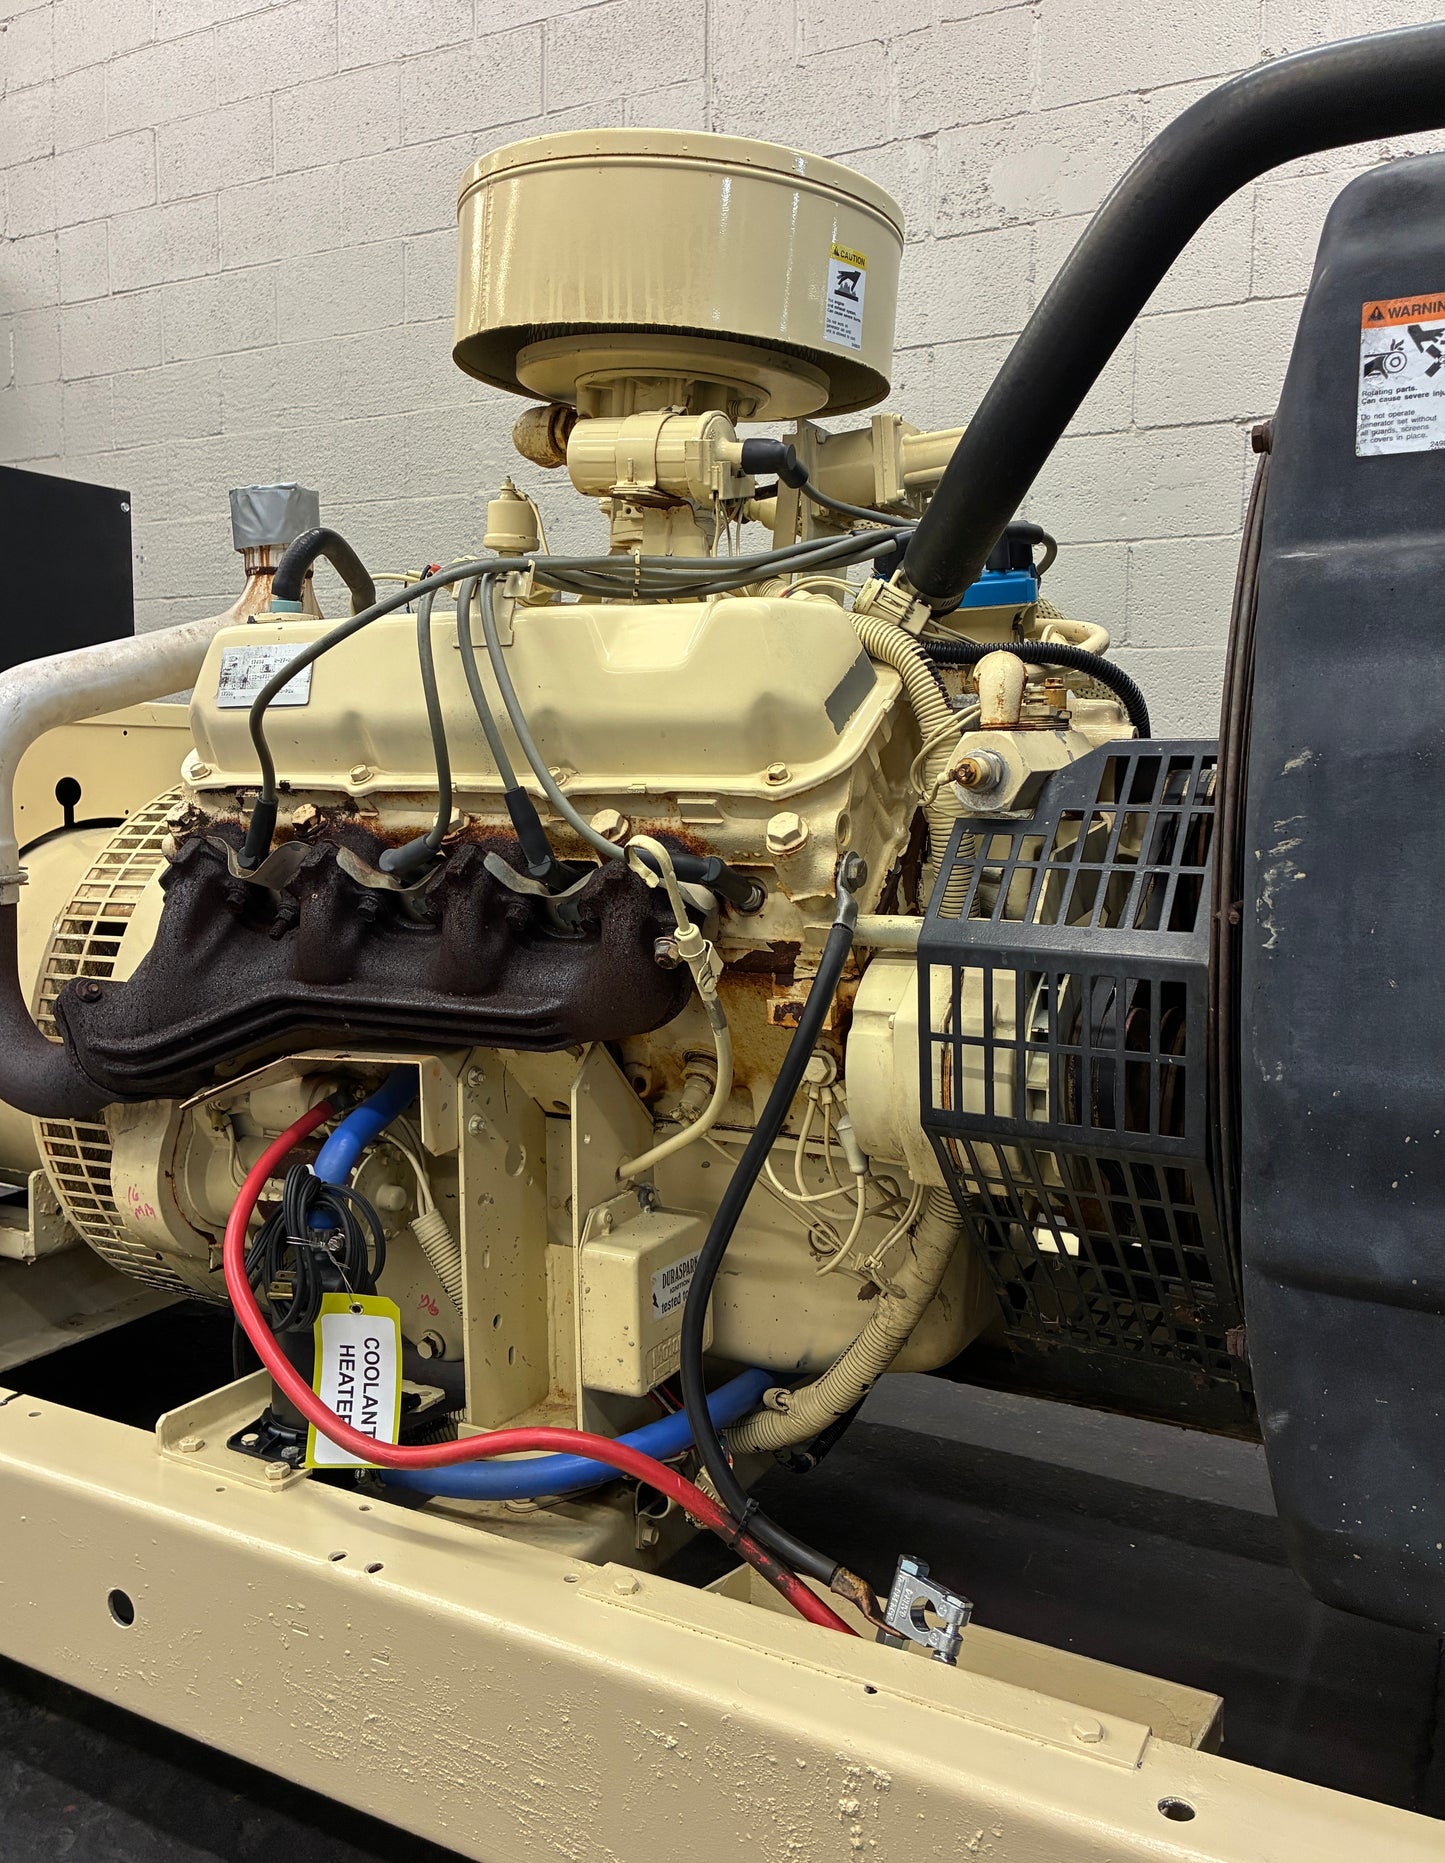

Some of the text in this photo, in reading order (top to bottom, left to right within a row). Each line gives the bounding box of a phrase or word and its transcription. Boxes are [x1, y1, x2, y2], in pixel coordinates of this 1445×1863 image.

[840, 250, 865, 266] CAUTION
[1361, 386, 1418, 397] Rotating parts.
[1379, 395, 1401, 403] cause
[1405, 392, 1430, 400] severe
[1374, 412, 1385, 420] not
[1388, 410, 1415, 420] operate
[1360, 420, 1394, 429] generator
[1411, 415, 1437, 423] without
[1401, 424, 1429, 432] screens
[1406, 433, 1428, 441] place.
[662, 1255, 699, 1289] DURASPARK
[661, 1292, 681, 1314] tested
[360, 1337, 381, 1440] COOLANT
